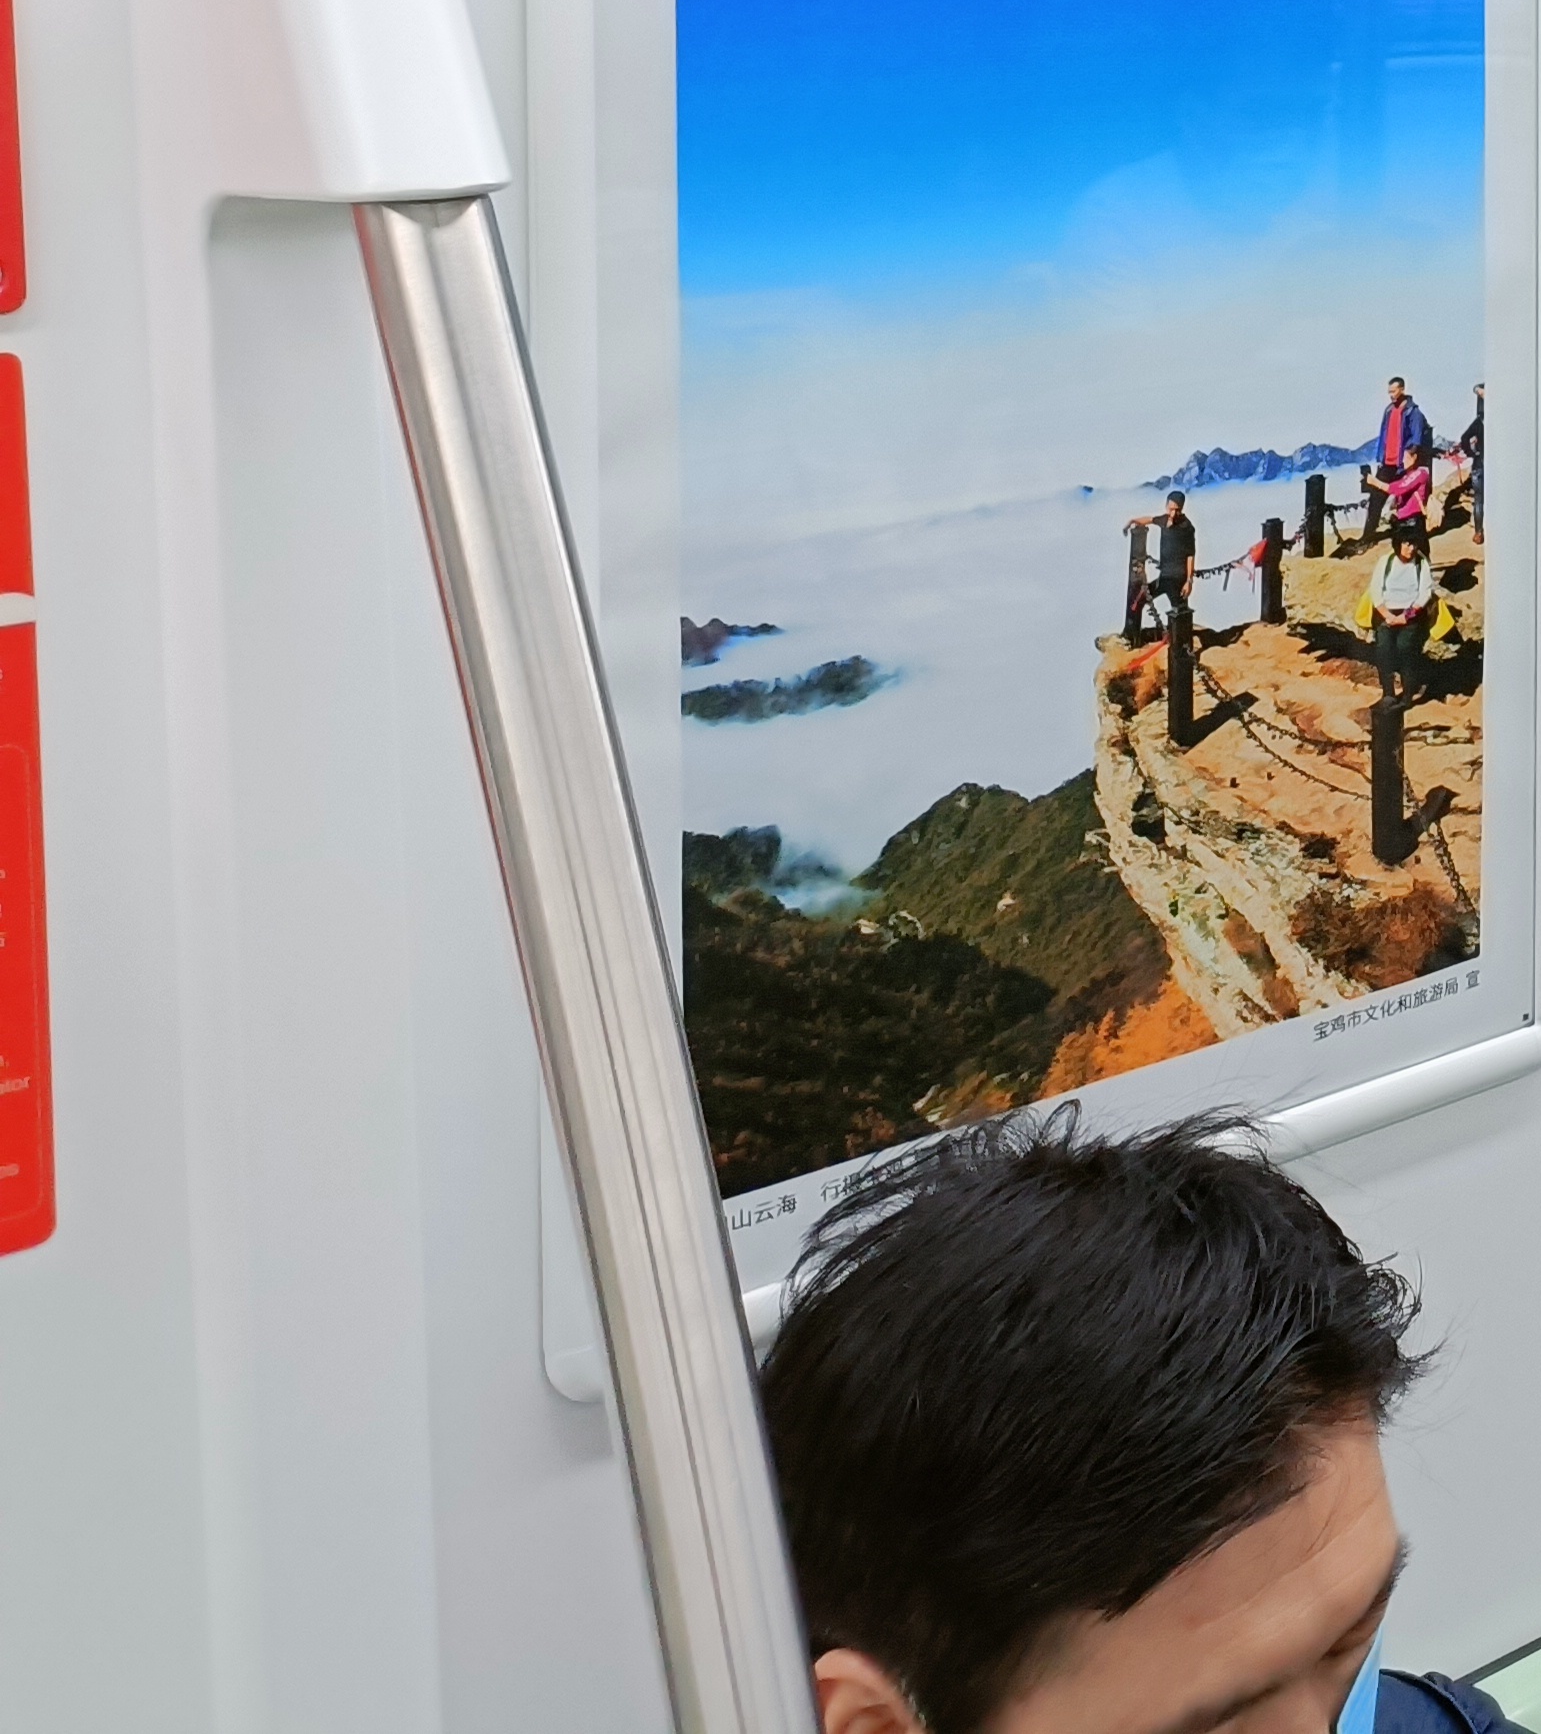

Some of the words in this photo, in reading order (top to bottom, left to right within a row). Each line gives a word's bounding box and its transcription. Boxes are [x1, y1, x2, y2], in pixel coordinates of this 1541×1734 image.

[1312, 977, 1459, 1043] 宝鸡市文化和旅游局
[1465, 969, 1481, 990] 宣
[725, 1193, 798, 1231] 山云海
